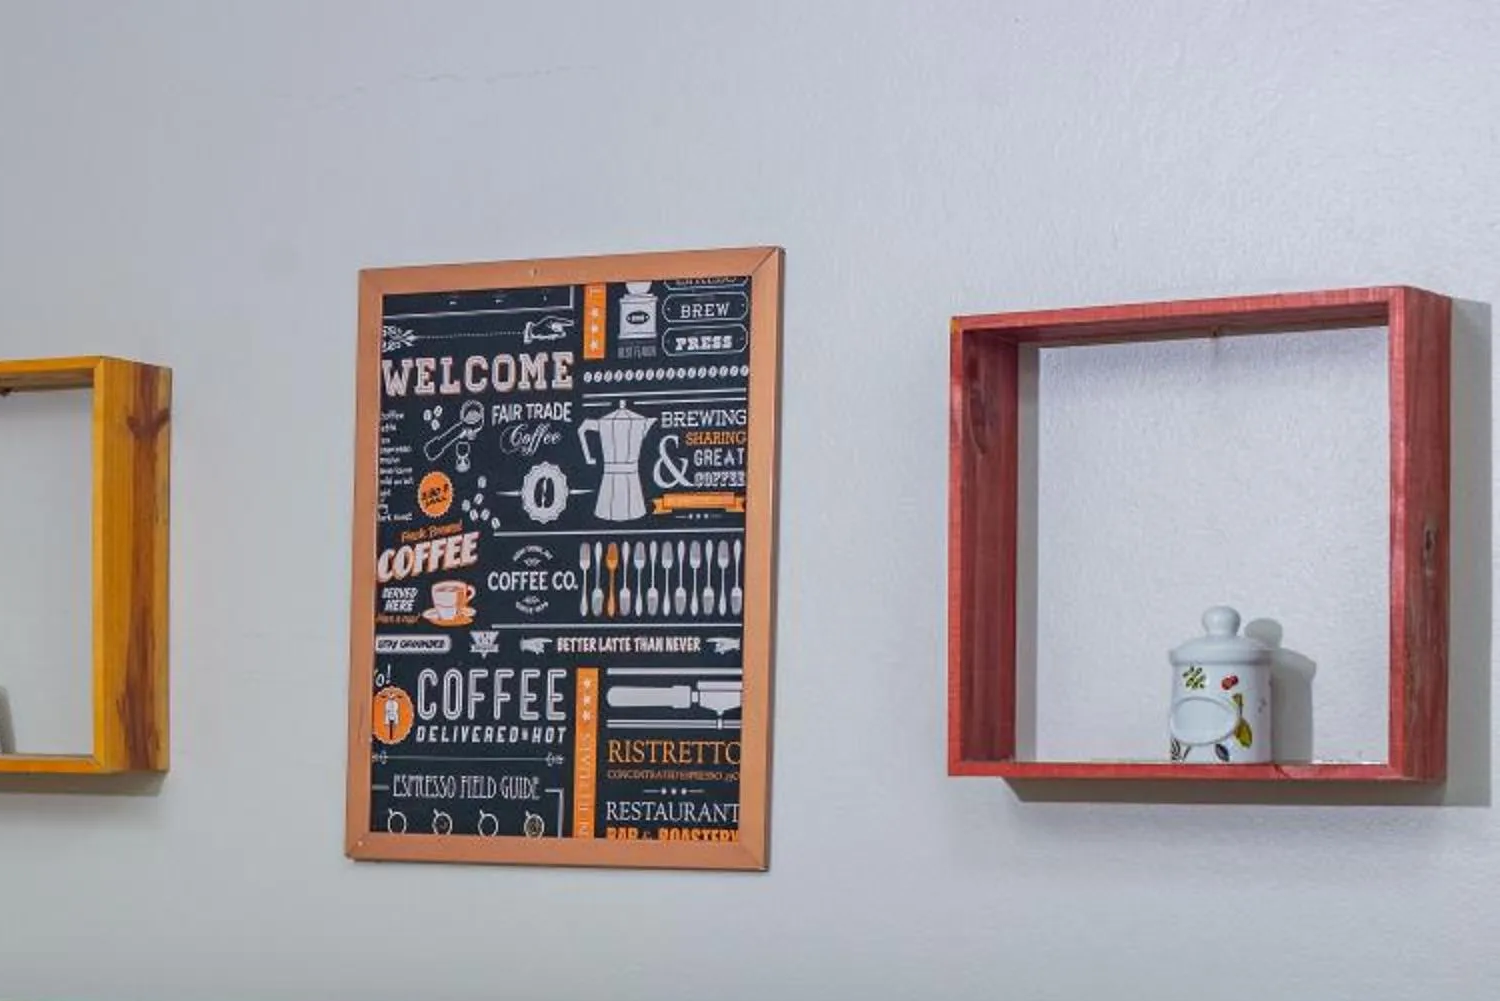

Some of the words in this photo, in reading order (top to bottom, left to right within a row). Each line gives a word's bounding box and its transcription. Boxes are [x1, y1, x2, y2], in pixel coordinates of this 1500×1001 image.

[680, 302, 731, 319] BREW
[675, 335, 733, 351] PRESS
[381, 351, 574, 397] WELCOME
[491, 403, 523, 426] FAIR
[525, 401, 573, 423] TRADE
[661, 409, 747, 428] BREWING
[501, 422, 562, 457] Coffee
[685, 431, 746, 445] SHARING
[653, 434, 695, 489] &
[693, 448, 745, 467] GREAT
[377, 531, 480, 583] COFFEE
[487, 571, 549, 591] COFFEE
[552, 571, 579, 591] CO.
[557, 636, 597, 653] BETTER
[600, 636, 631, 652] LATTE
[633, 636, 664, 652] THAN
[665, 636, 701, 652] NEVER
[374, 664, 392, 687] o!
[417, 668, 567, 721] COFFEE
[415, 725, 518, 743] DELIVERED
[532, 725, 567, 744] HOT
[608, 739, 741, 764] RISTRETTO
[392, 773, 456, 799] ESPRESSO
[459, 774, 497, 799] FIELD
[500, 775, 541, 800] GUIDE
[606, 801, 740, 822] RESTAURANT
